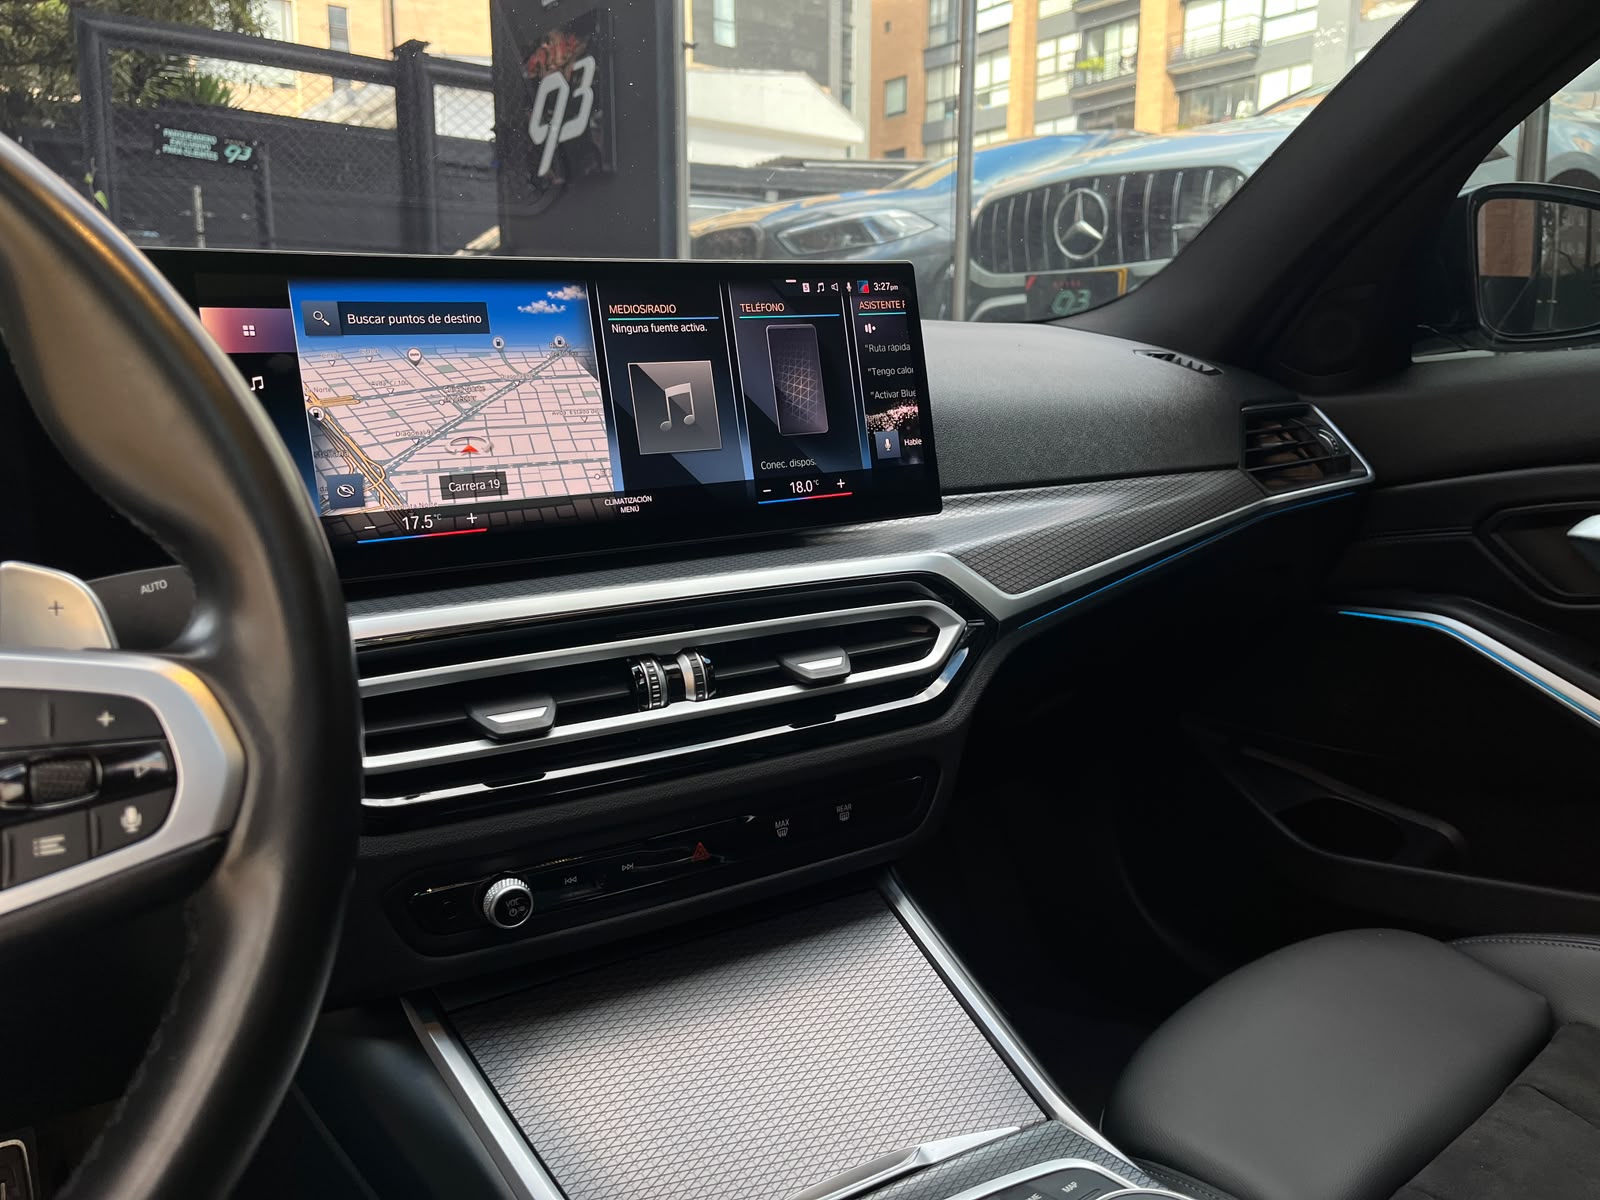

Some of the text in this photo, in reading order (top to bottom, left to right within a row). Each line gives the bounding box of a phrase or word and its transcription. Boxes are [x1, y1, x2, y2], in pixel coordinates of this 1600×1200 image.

[528, 55, 596, 177] 93
[224, 145, 252, 163] 93
[608, 303, 677, 314] MEDIOS/RADIO
[740, 303, 785, 313] TELÉFONO
[859, 300, 900, 310] ASISTENTE
[347, 313, 482, 327] Buscar puntos de destino
[611, 322, 708, 335] Ninguna fuente activa.
[760, 457, 817, 470] Conec. dispos.
[448, 479, 501, 492] Carrera 19
[604, 495, 653, 507] CLIMATIZACIÓN
[620, 505, 640, 514] MENÚ
[140, 579, 168, 594] AUTO
[836, 804, 852, 813] REAR
[775, 819, 790, 829] MAX
[1061, 1181, 1077, 1193] MAP
